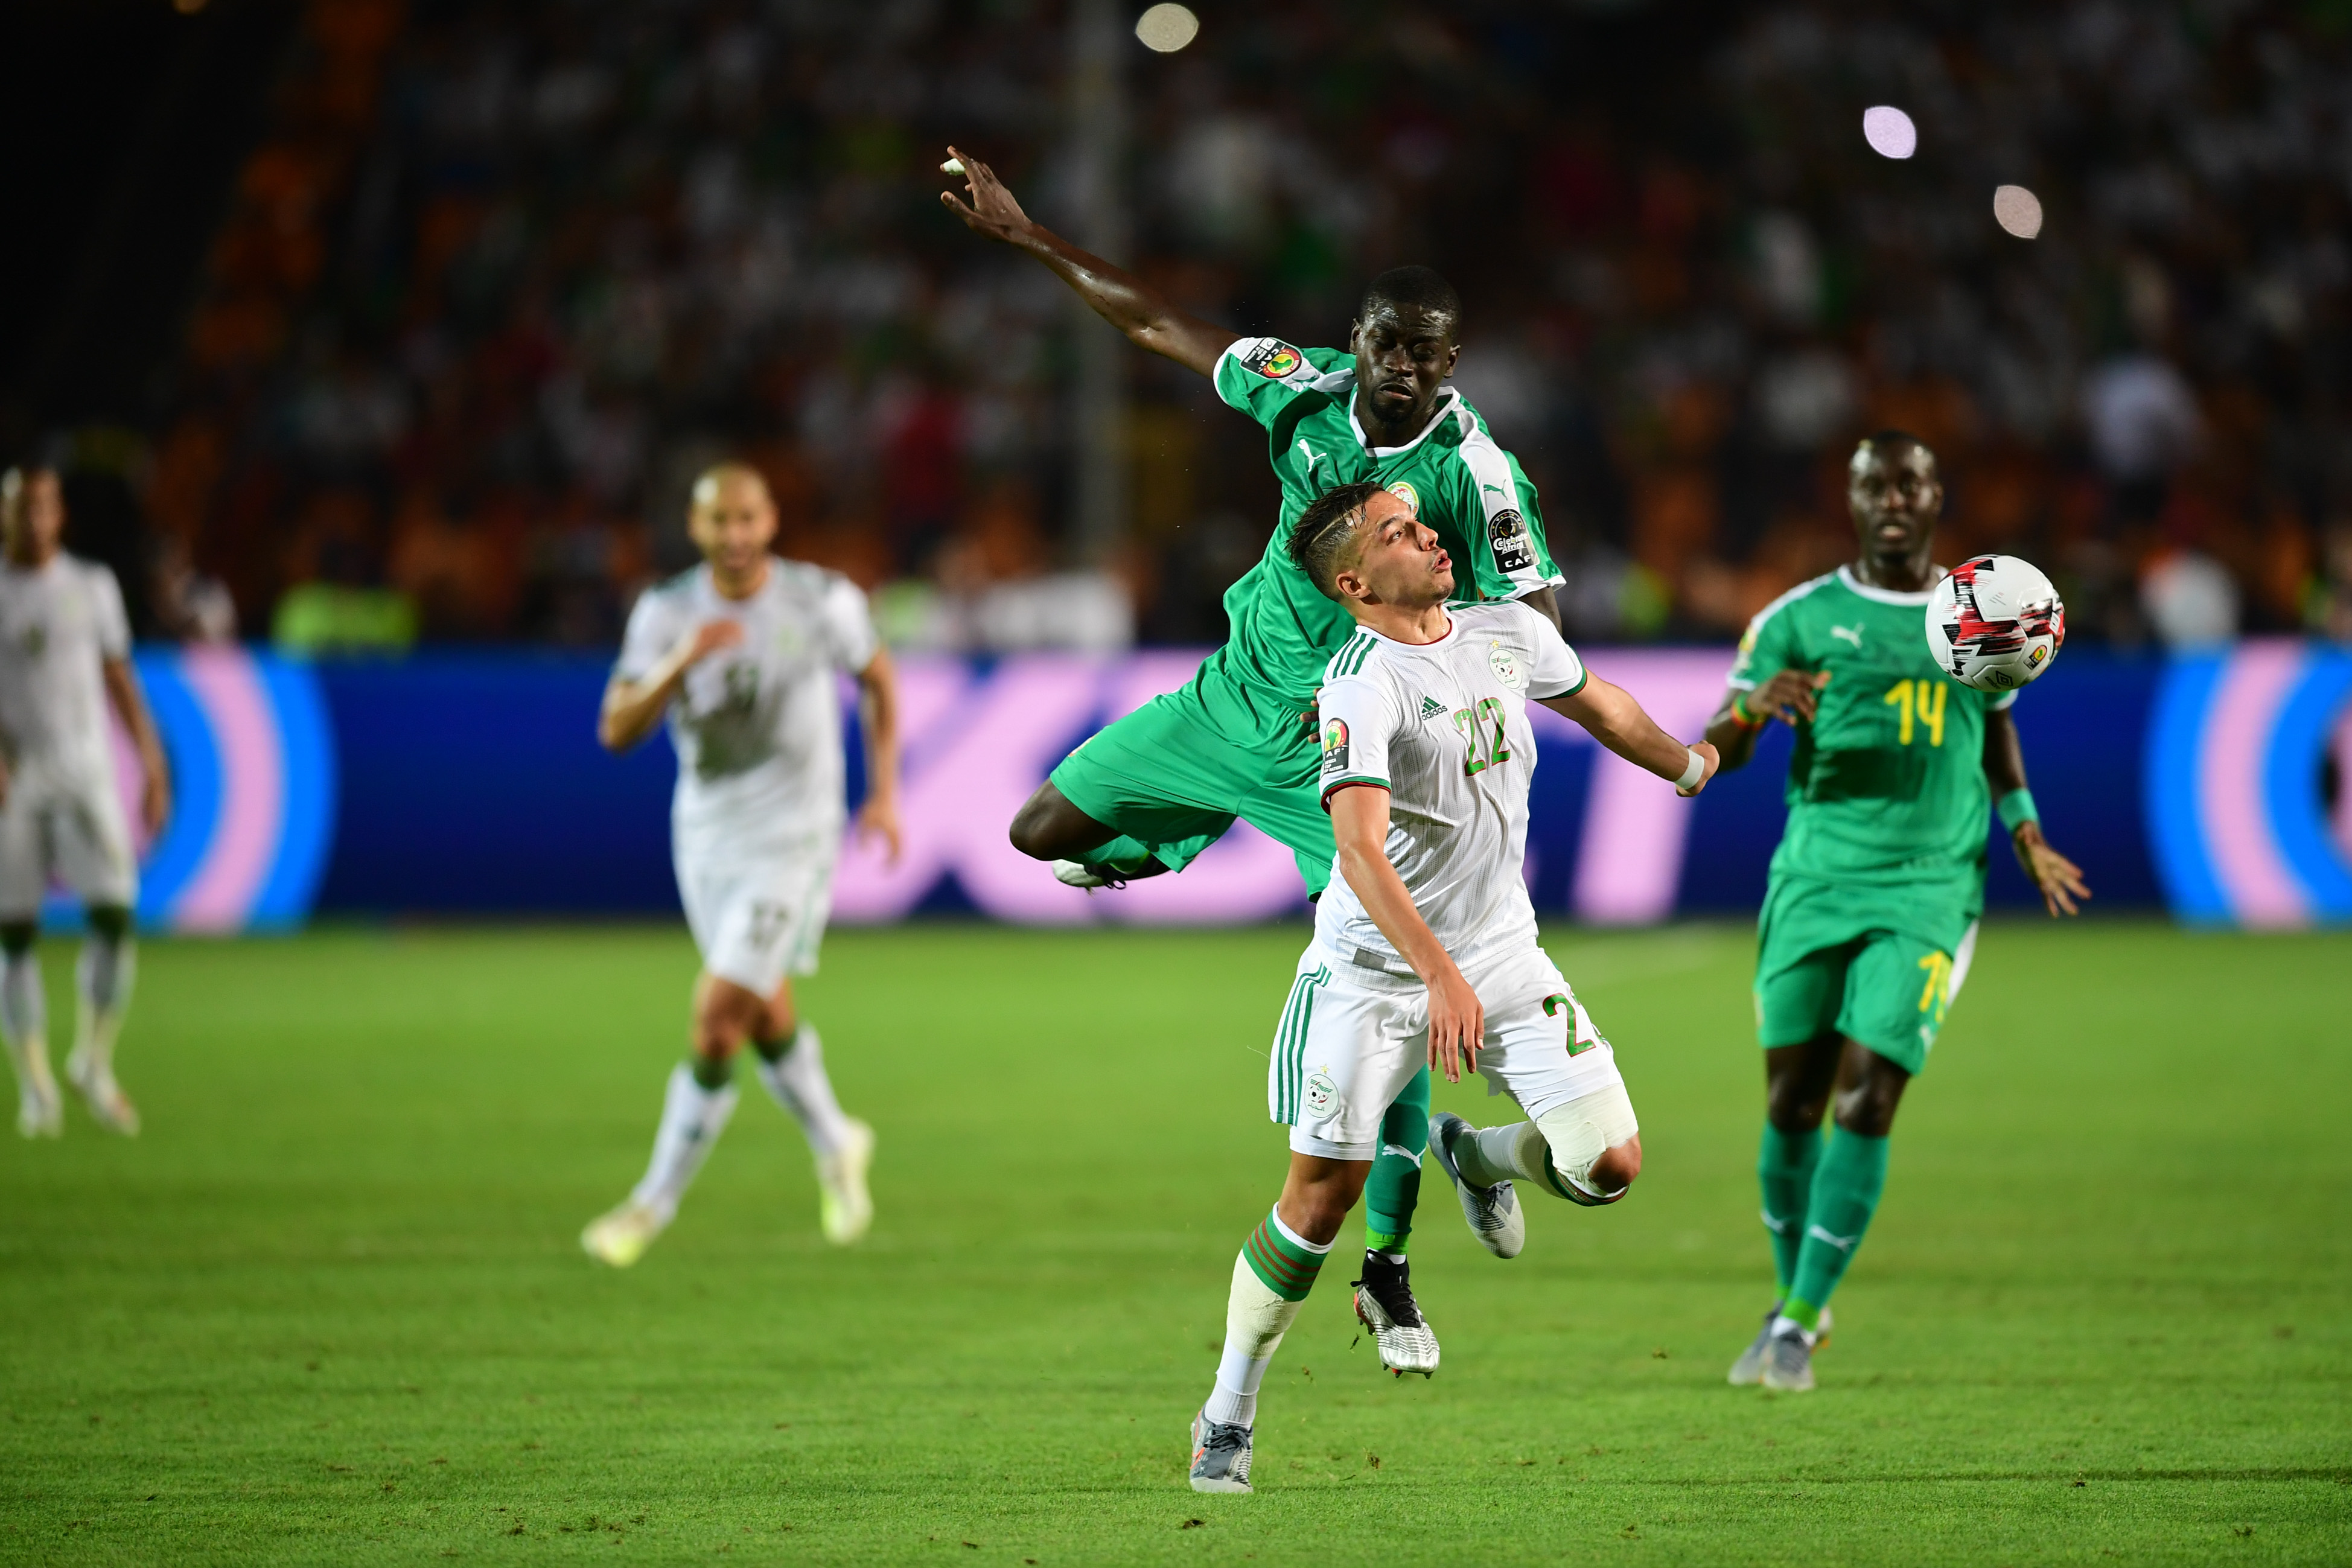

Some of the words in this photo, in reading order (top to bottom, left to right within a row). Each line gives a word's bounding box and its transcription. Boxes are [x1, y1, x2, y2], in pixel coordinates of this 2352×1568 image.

[1260, 348, 1280, 366] CAF
[1493, 534, 1528, 550] Celebrate
[1502, 541, 1523, 555] Africa
[1505, 555, 1531, 567] CAF
[1421, 705, 1448, 721] adidas
[1884, 679, 1948, 747] 14
[1453, 696, 1511, 777] 22
